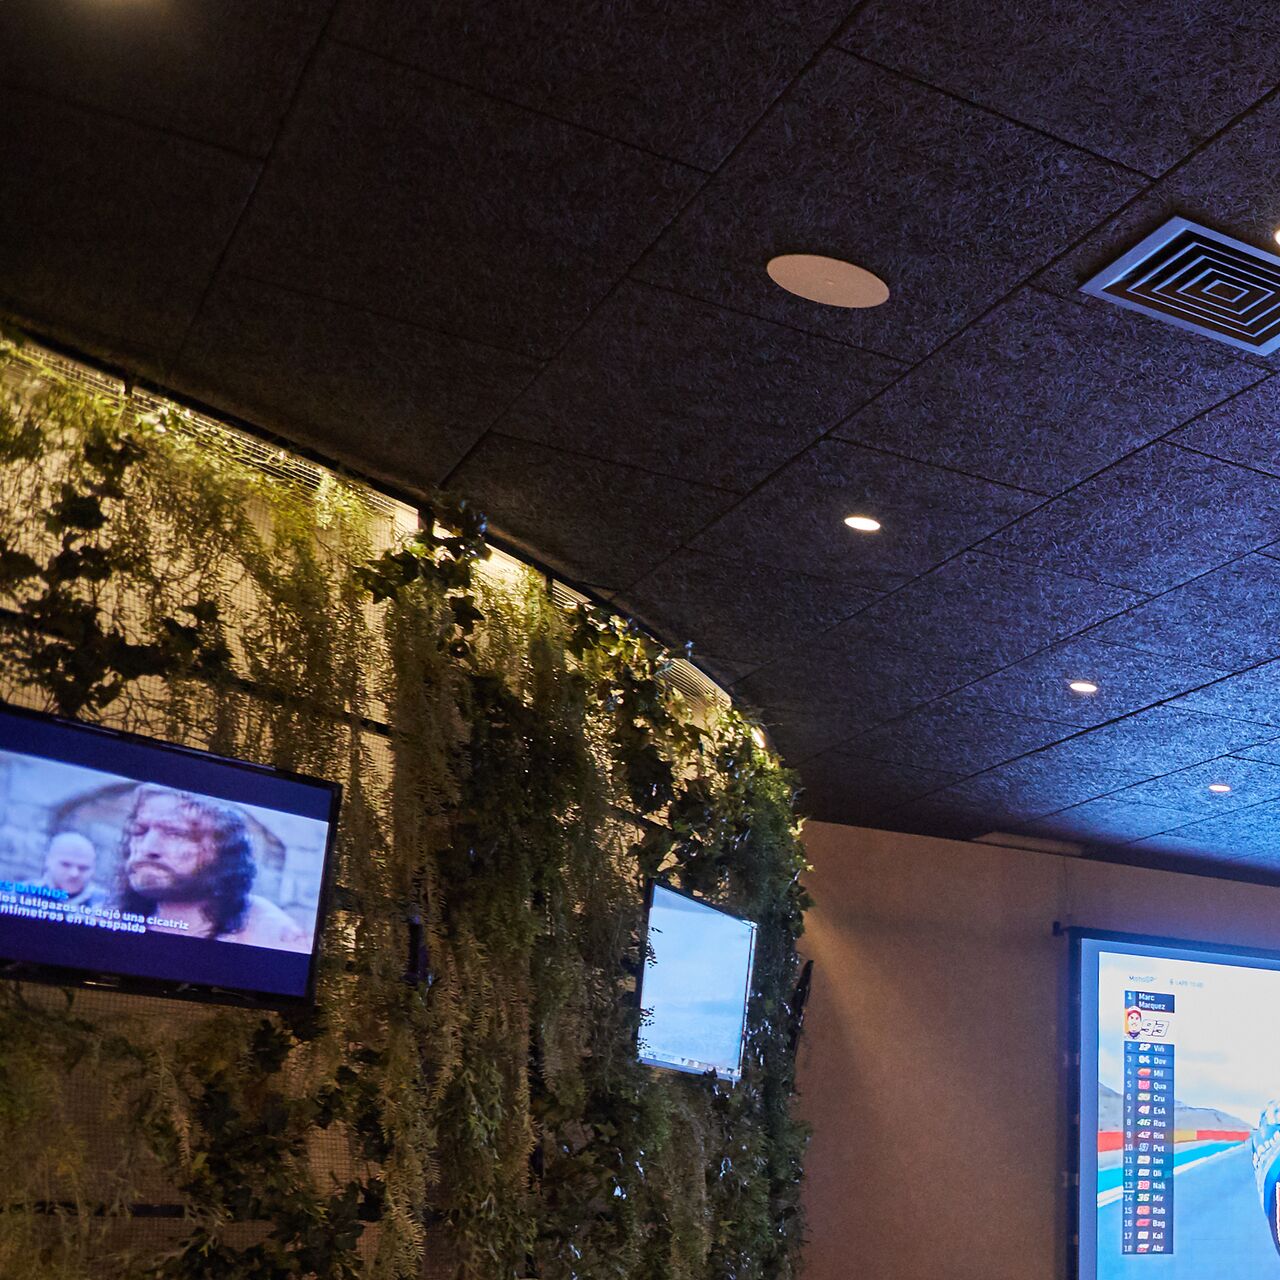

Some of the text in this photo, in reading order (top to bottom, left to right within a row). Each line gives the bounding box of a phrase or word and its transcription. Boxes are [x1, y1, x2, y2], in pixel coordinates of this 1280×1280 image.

[15, 881, 69, 900] DIVINOS
[20, 896, 76, 912] latigazos
[123, 913, 145, 924] una
[146, 917, 189, 930] cicatriz
[66, 913, 82, 924] en
[85, 915, 96, 926] la
[99, 919, 146, 934] espalda
[1139, 993, 1155, 1001] Marc
[1139, 1001, 1165, 1010] Marquez
[1154, 1082, 1166, 1091] Qua
[1154, 1107, 1166, 1115] EsA
[1153, 1220, 1165, 1228] Bag
[1152, 1244, 1164, 1252] Abr
